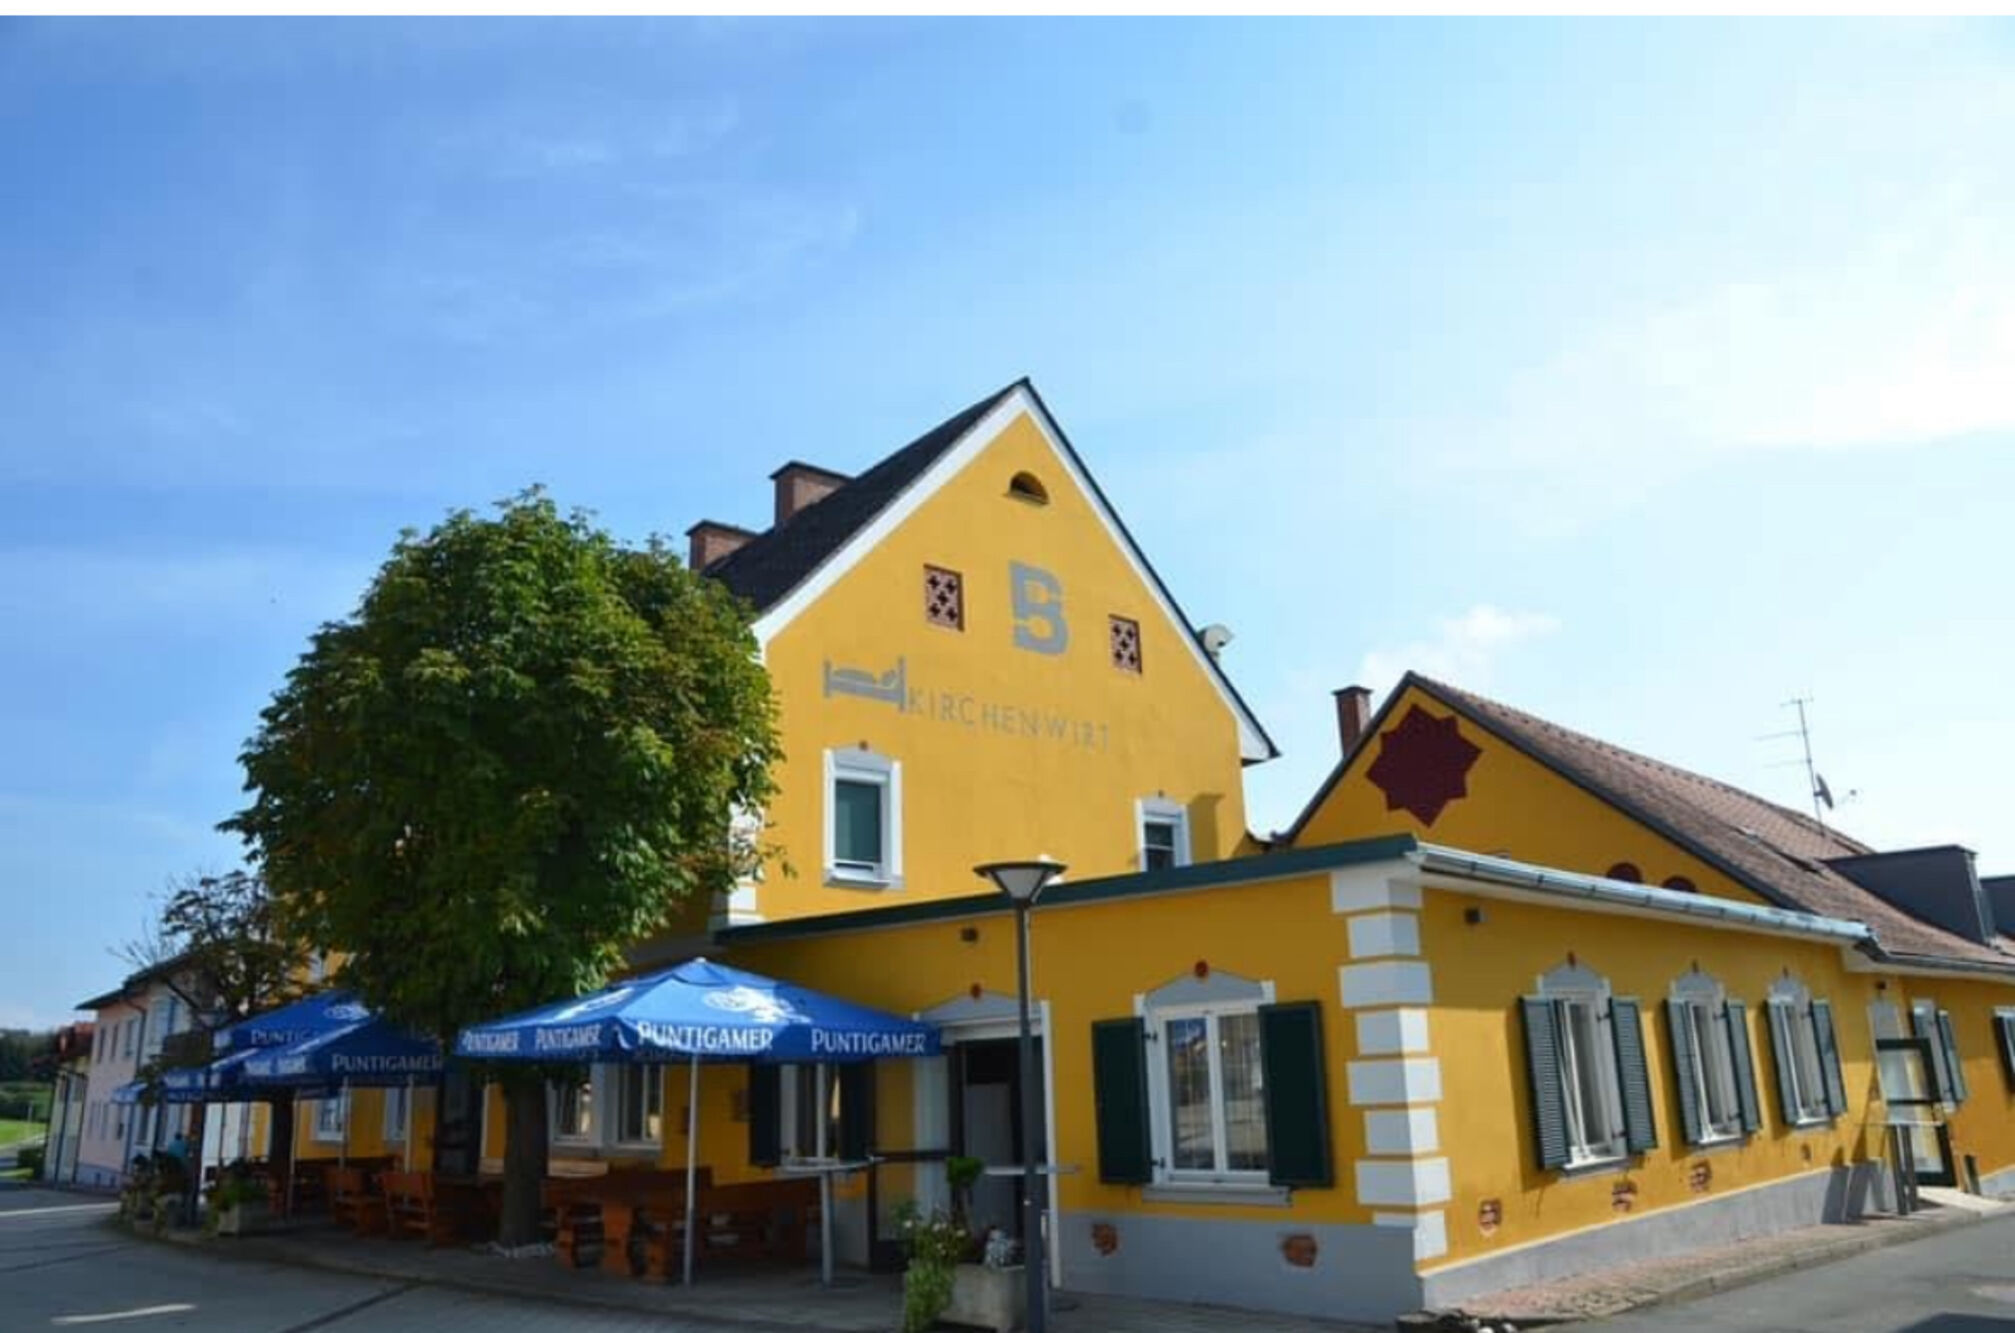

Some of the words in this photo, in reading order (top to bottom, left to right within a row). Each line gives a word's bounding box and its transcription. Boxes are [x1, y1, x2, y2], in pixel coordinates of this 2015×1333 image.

[906, 687, 1109, 751] KIRCHENWIRT
[535, 1024, 602, 1050] PUNTIGAMER
[637, 1021, 774, 1050] PUNTIGAMER
[811, 1028, 927, 1054] PUNTIGAMER
